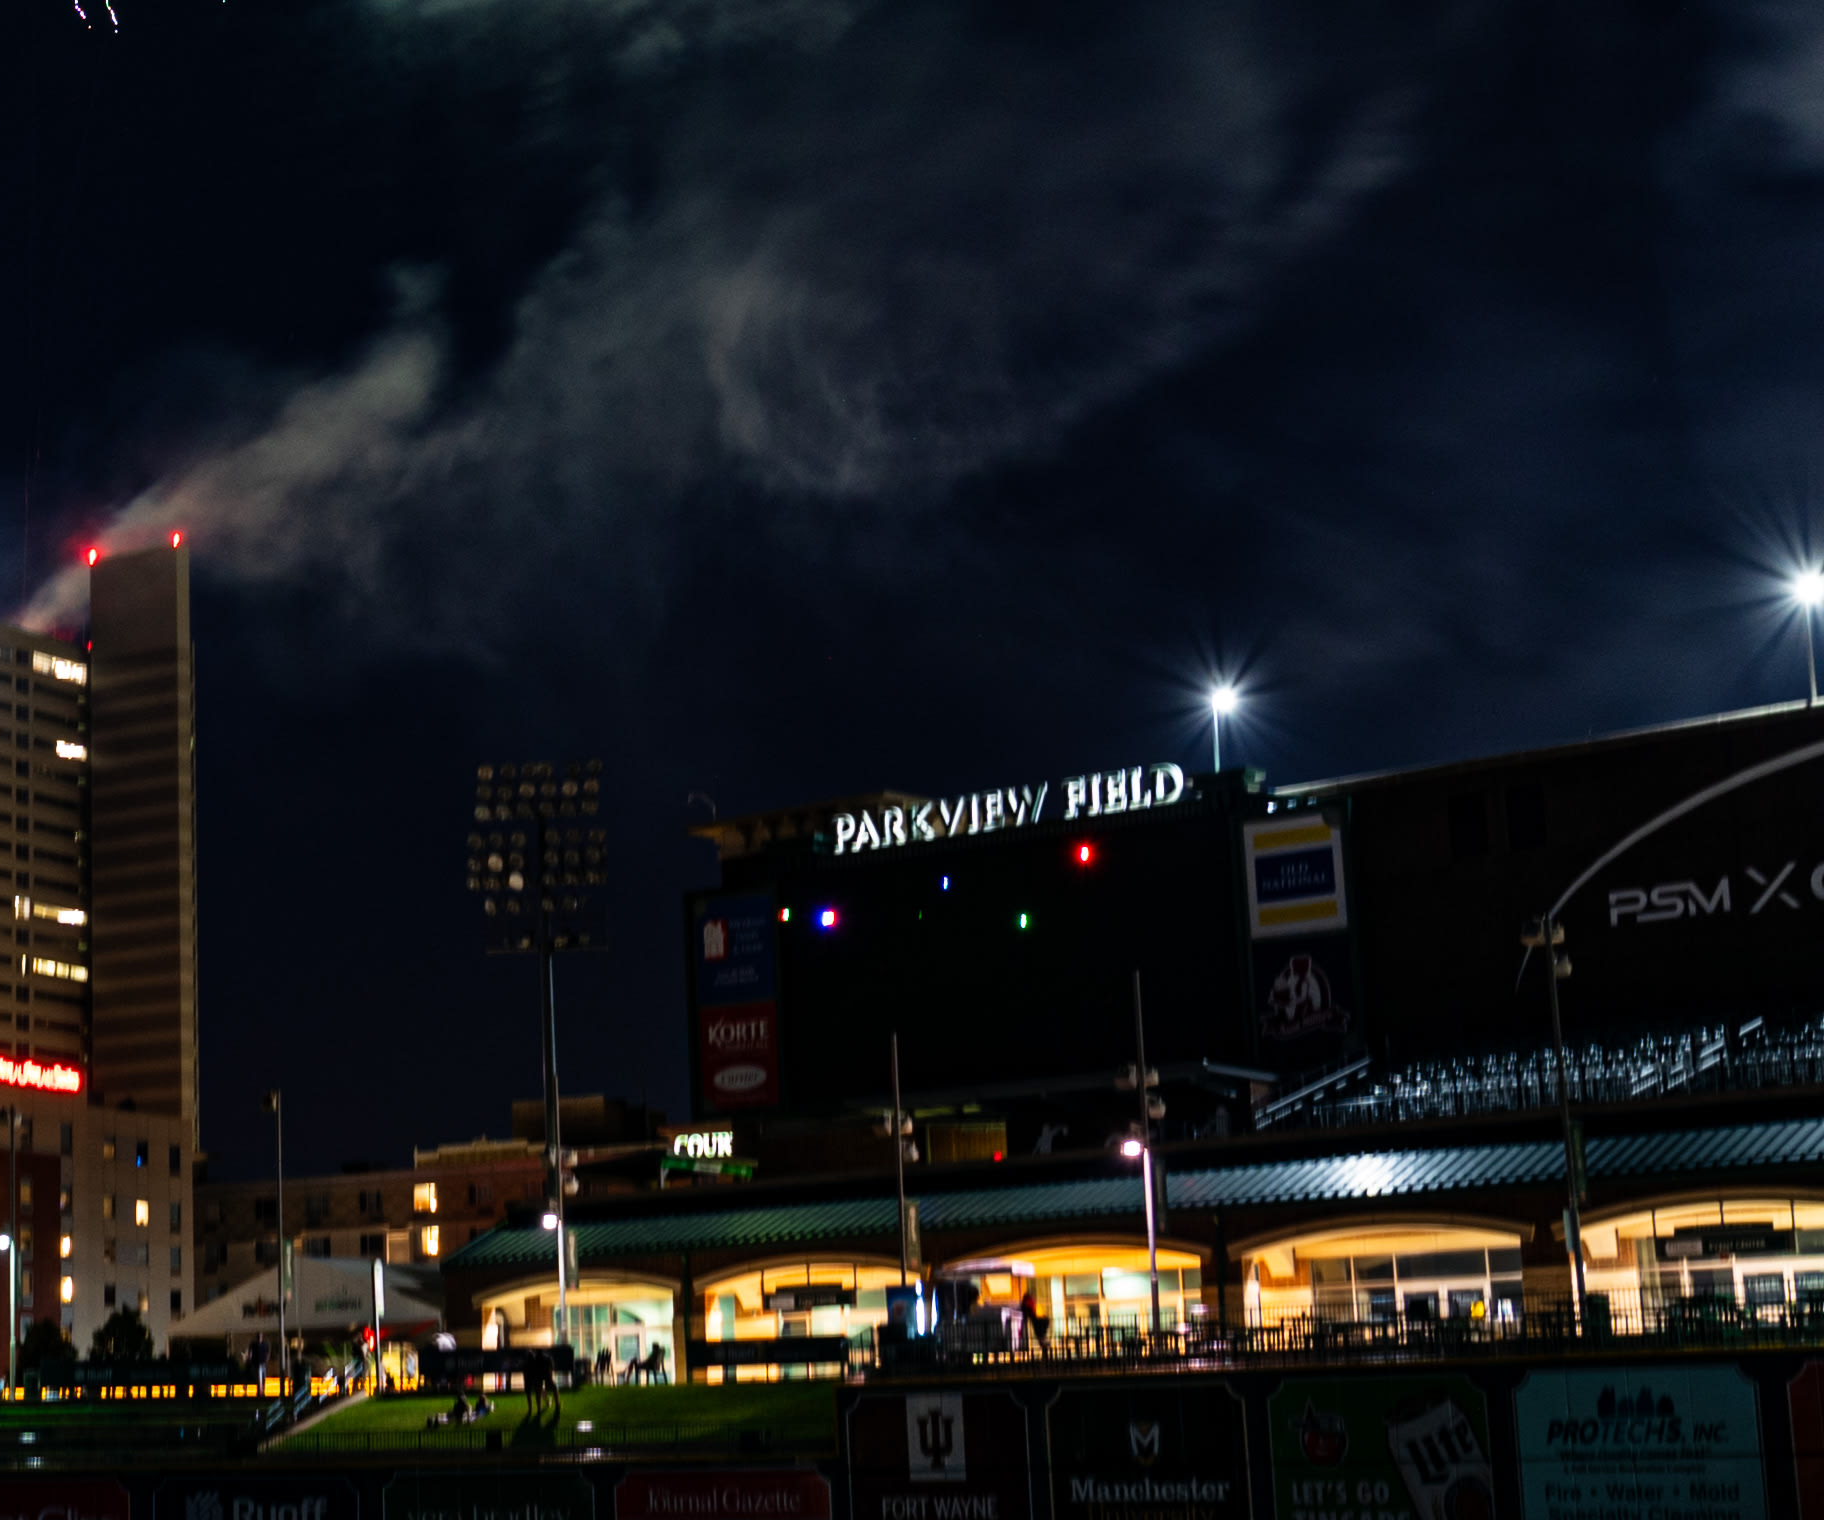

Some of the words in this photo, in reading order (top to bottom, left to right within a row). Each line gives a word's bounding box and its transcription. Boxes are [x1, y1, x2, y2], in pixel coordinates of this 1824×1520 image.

[833, 781, 1048, 856] PARKVIEW
[1061, 762, 1185, 821] FIELD
[1608, 874, 1732, 928] PSM
[707, 1016, 769, 1047] KORTE
[673, 1131, 734, 1159] COUR
[646, 1483, 719, 1515] Journal
[721, 1485, 802, 1515] Gazette
[1068, 1471, 1232, 1504] Manchester
[1291, 1478, 1348, 1506] LET'S
[1355, 1479, 1391, 1506] GO
[1546, 1482, 1583, 1502] Fire
[1606, 1481, 1664, 1501] Water
[1689, 1480, 1740, 1502] Mold
